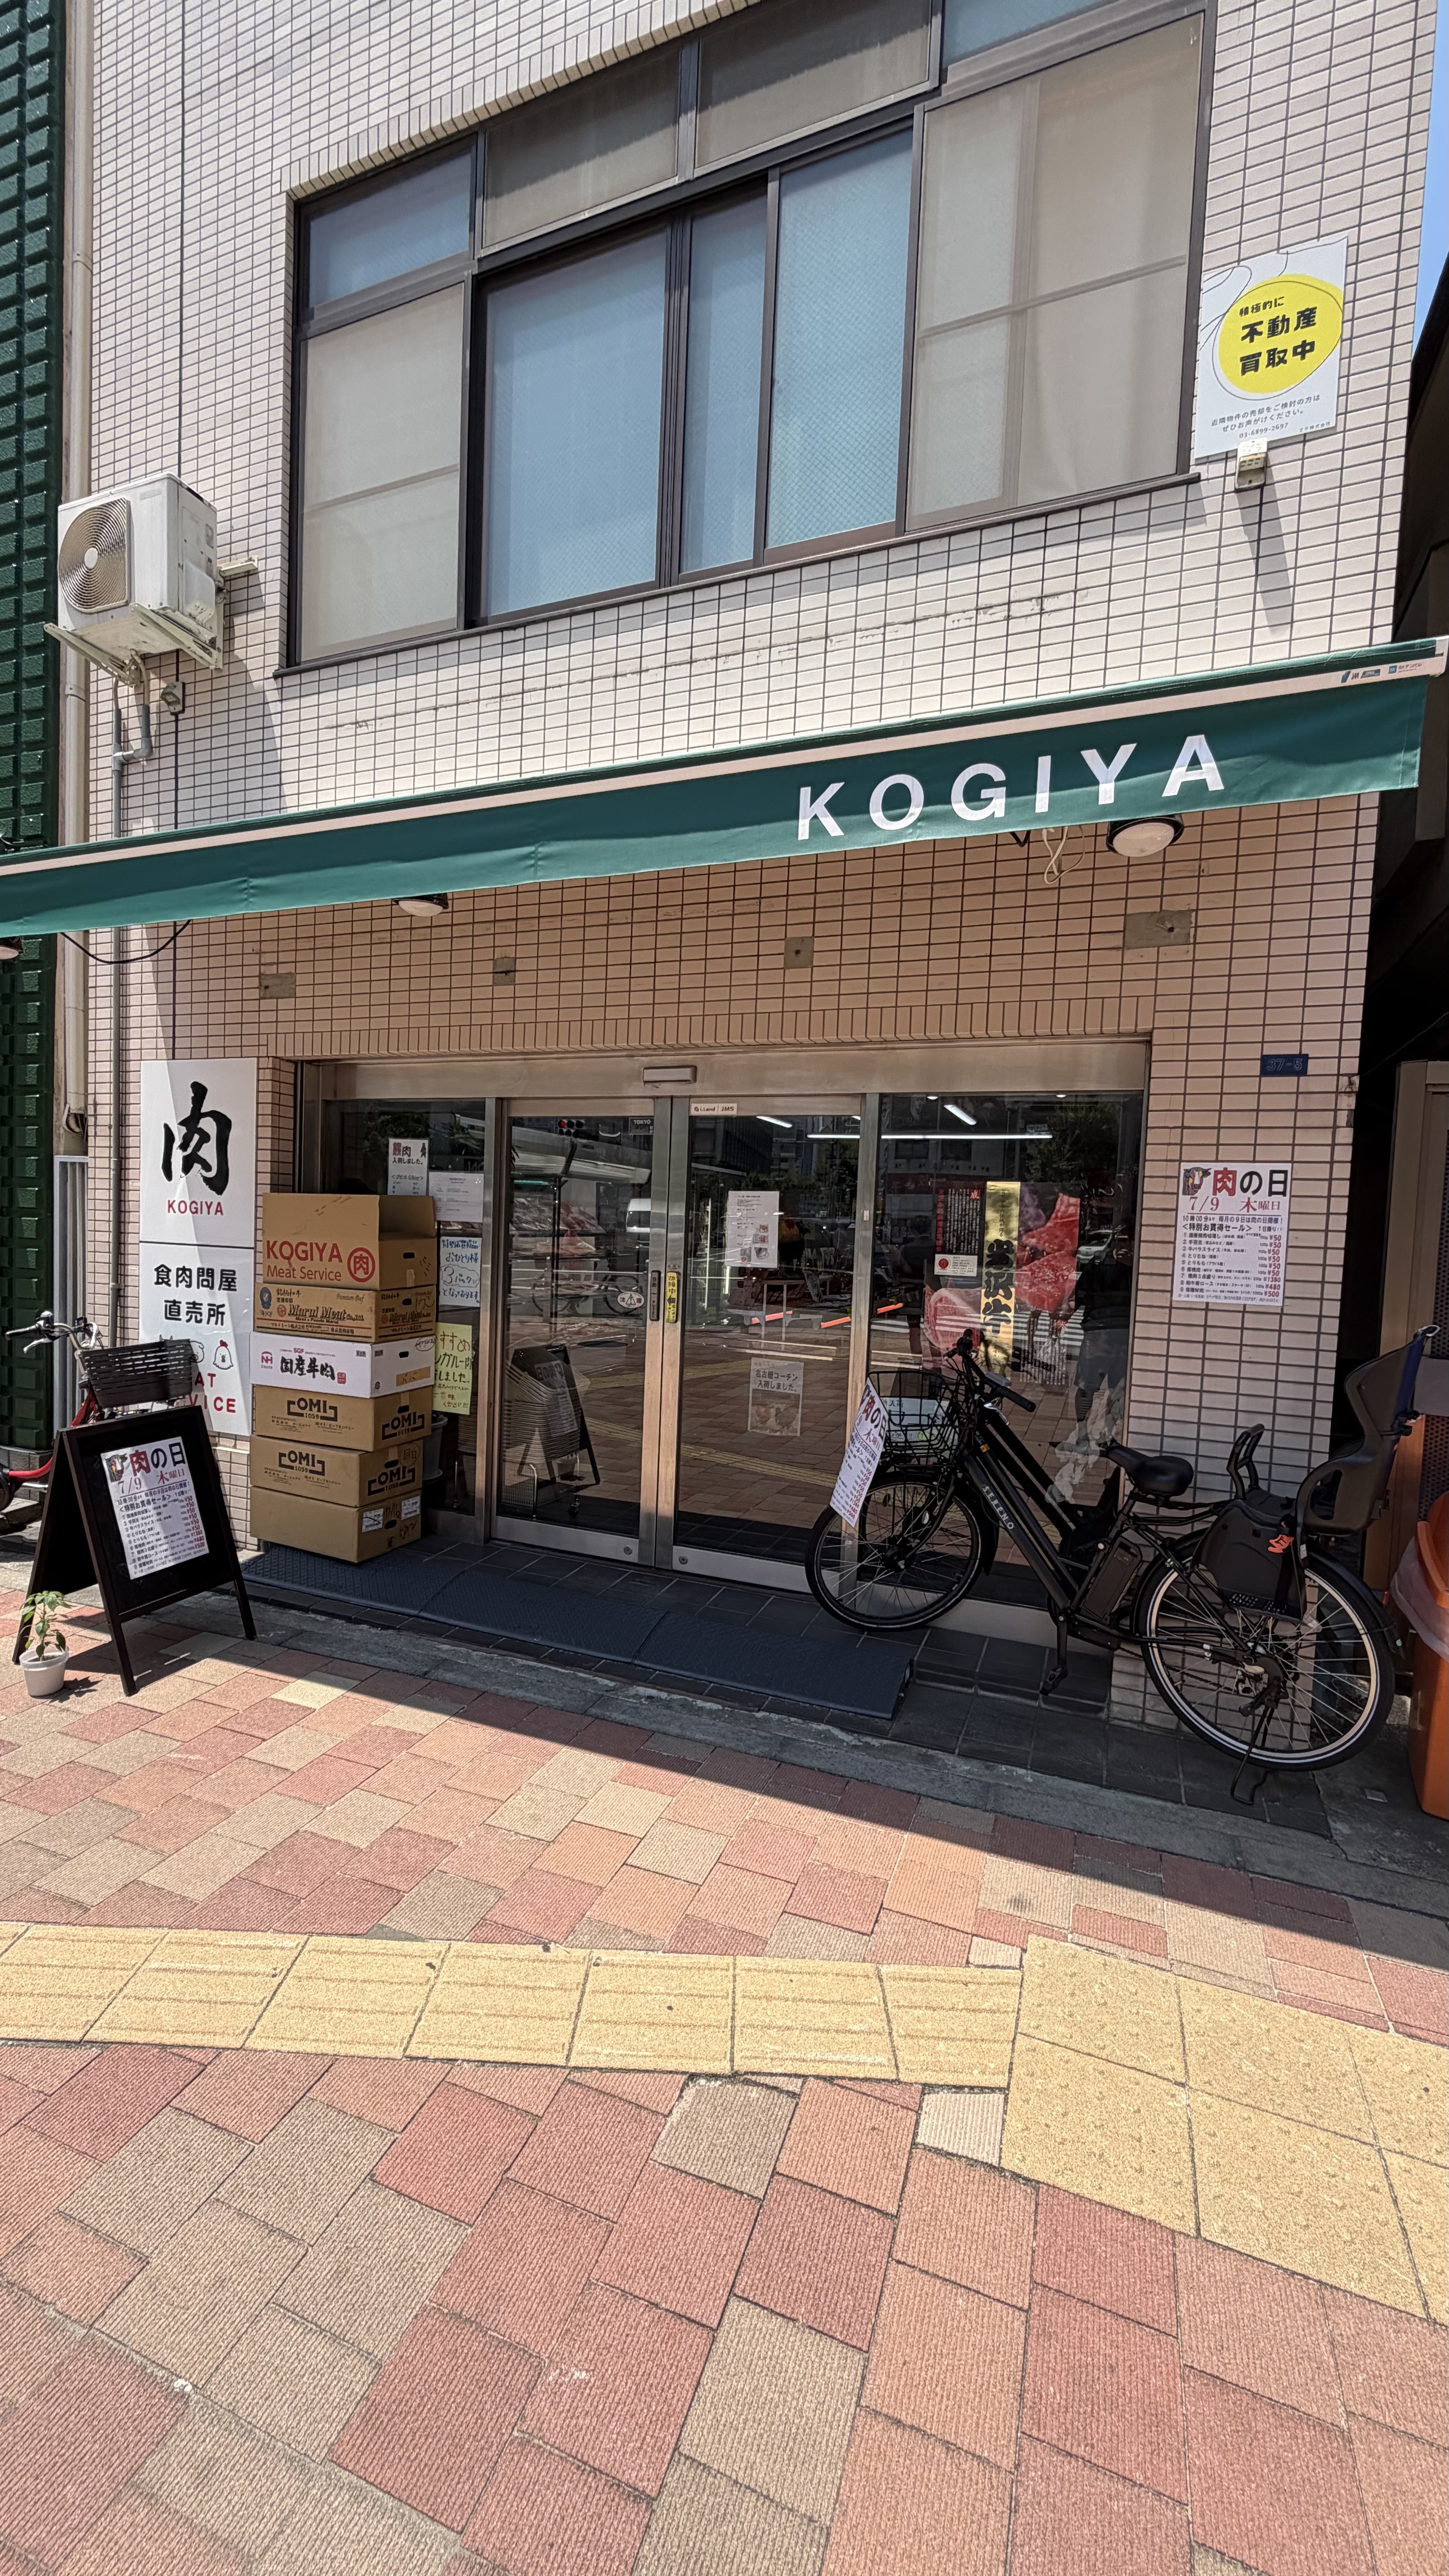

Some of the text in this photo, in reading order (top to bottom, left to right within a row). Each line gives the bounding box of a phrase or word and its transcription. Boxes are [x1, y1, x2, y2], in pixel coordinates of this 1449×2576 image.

[1241, 307, 1317, 343] 不動産
[1240, 339, 1315, 376] 買取中
[1211, 395, 1320, 426] 近隣物件の売却をご検討の方は
[1222, 409, 1304, 432] ぜひお声がけください。
[1239, 423, 1288, 438] 03-6899-2697
[798, 734, 1225, 840] KOGIYA
[1267, 1058, 1302, 1071] 37-5
[161, 1081, 232, 1196] 肉
[1212, 1167, 1288, 1197] 肉の日
[167, 1200, 223, 1216] KOGIYA
[1189, 1196, 1280, 1213] 7/9 木曜日
[267, 1240, 343, 1263] KOGIYA
[267, 1265, 341, 1281] Meat Service
[354, 1254, 369, 1275] 肉
[154, 1264, 237, 1292] 食肉問屋
[164, 1299, 225, 1326] 直売所
[321, 1306, 346, 1320] Meat
[436, 1331, 470, 1352] すすめ
[280, 1355, 336, 1380] 国産牛肉
[435, 1352, 472, 1370] ンガルー肉
[195, 1371, 216, 1388] AT
[435, 1369, 469, 1383] しました。
[755, 1369, 798, 1381] 名古屋コーチン
[758, 1380, 797, 1392] 入荷しました。
[189, 1394, 236, 1413] VICE
[297, 1398, 327, 1413] OMI
[391, 1412, 417, 1430] OMI
[862, 1394, 887, 1443] 肉の日
[129, 1442, 186, 1477] 肉の日
[288, 1450, 315, 1467] OMI
[118, 1468, 184, 1494] 7/9 木曜日
[378, 1466, 406, 1485] OMI
[983, 1486, 1014, 1529] SERENO
